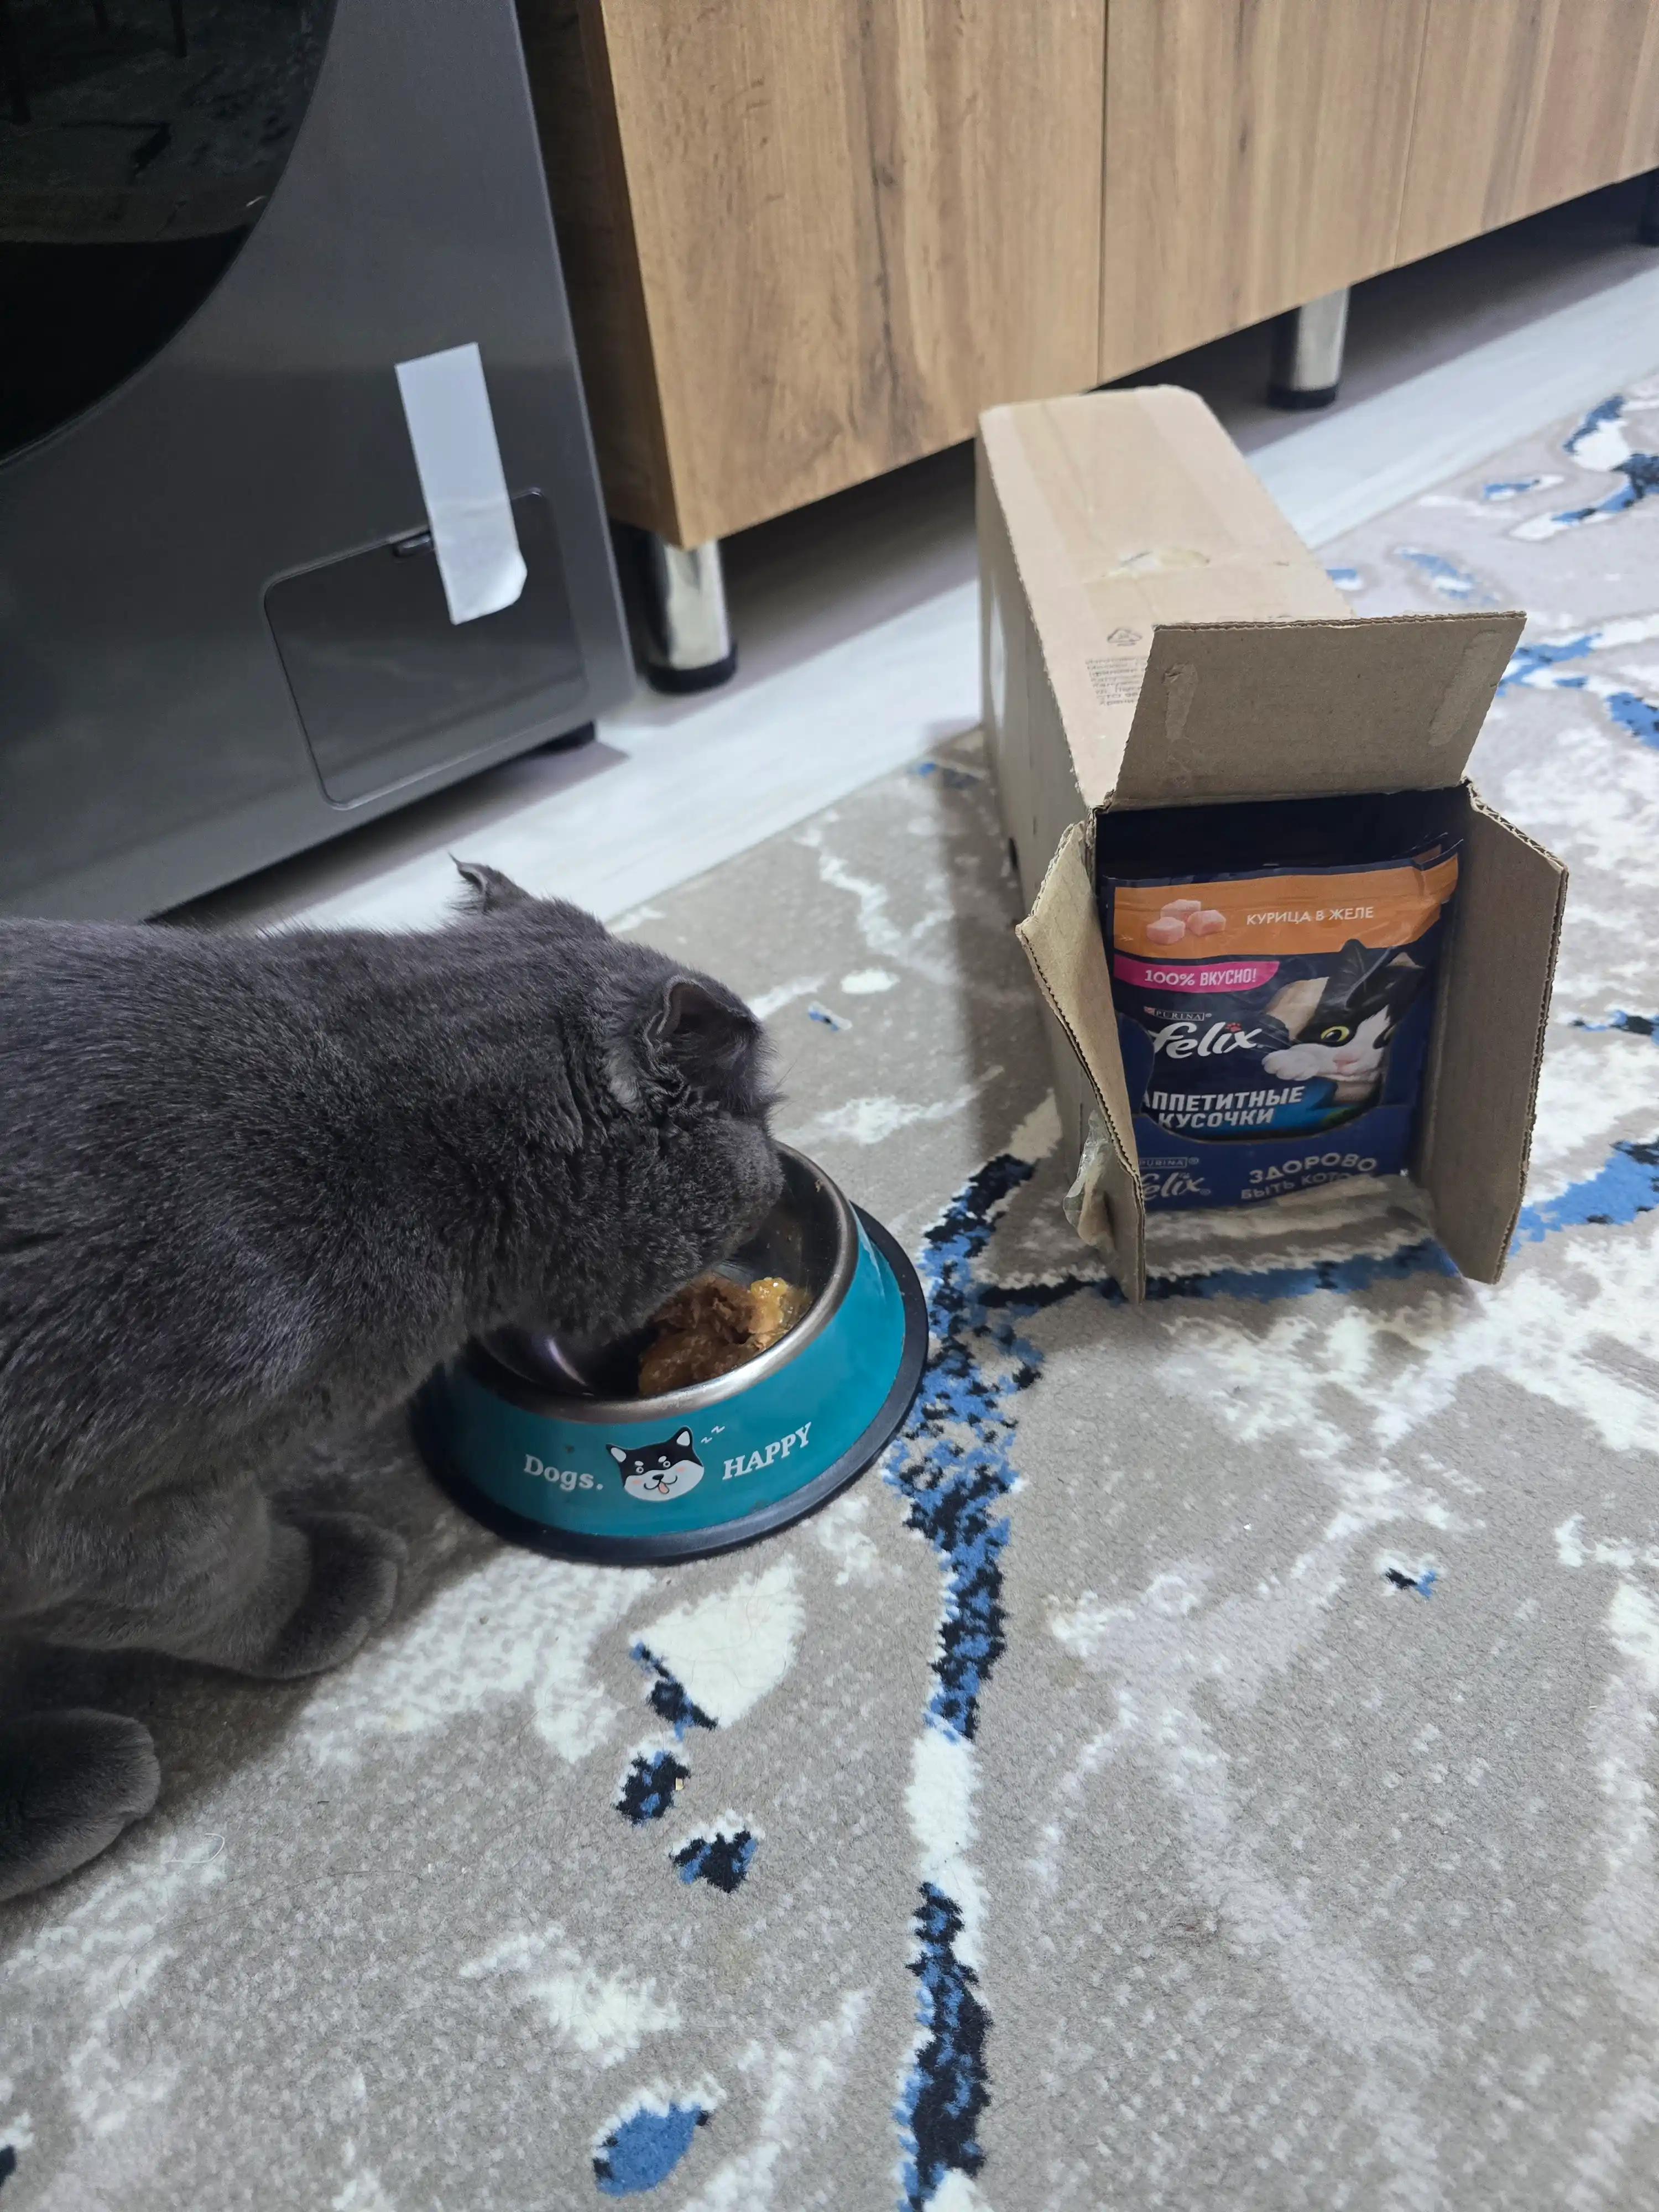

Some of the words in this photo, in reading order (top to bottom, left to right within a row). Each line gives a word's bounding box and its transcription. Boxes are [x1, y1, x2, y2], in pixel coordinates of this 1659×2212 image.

[1246, 911, 1311, 925] КУРИЦА
[1316, 910, 1325, 921] В
[1328, 906, 1374, 920] ЖЕЛЕ
[1145, 969, 1195, 986] 100%
[1200, 968, 1257, 986] ВКУСНО!
[1156, 1011, 1201, 1020] PURINA
[1159, 1108, 1274, 1128] КУСОЧКИ
[1249, 1152, 1377, 1183] ЗДОРОВО
[1241, 1181, 1295, 1199] БЫТЬ
[722, 1422, 812, 1480] HAPPY
[523, 1454, 603, 1491] Dogs.
